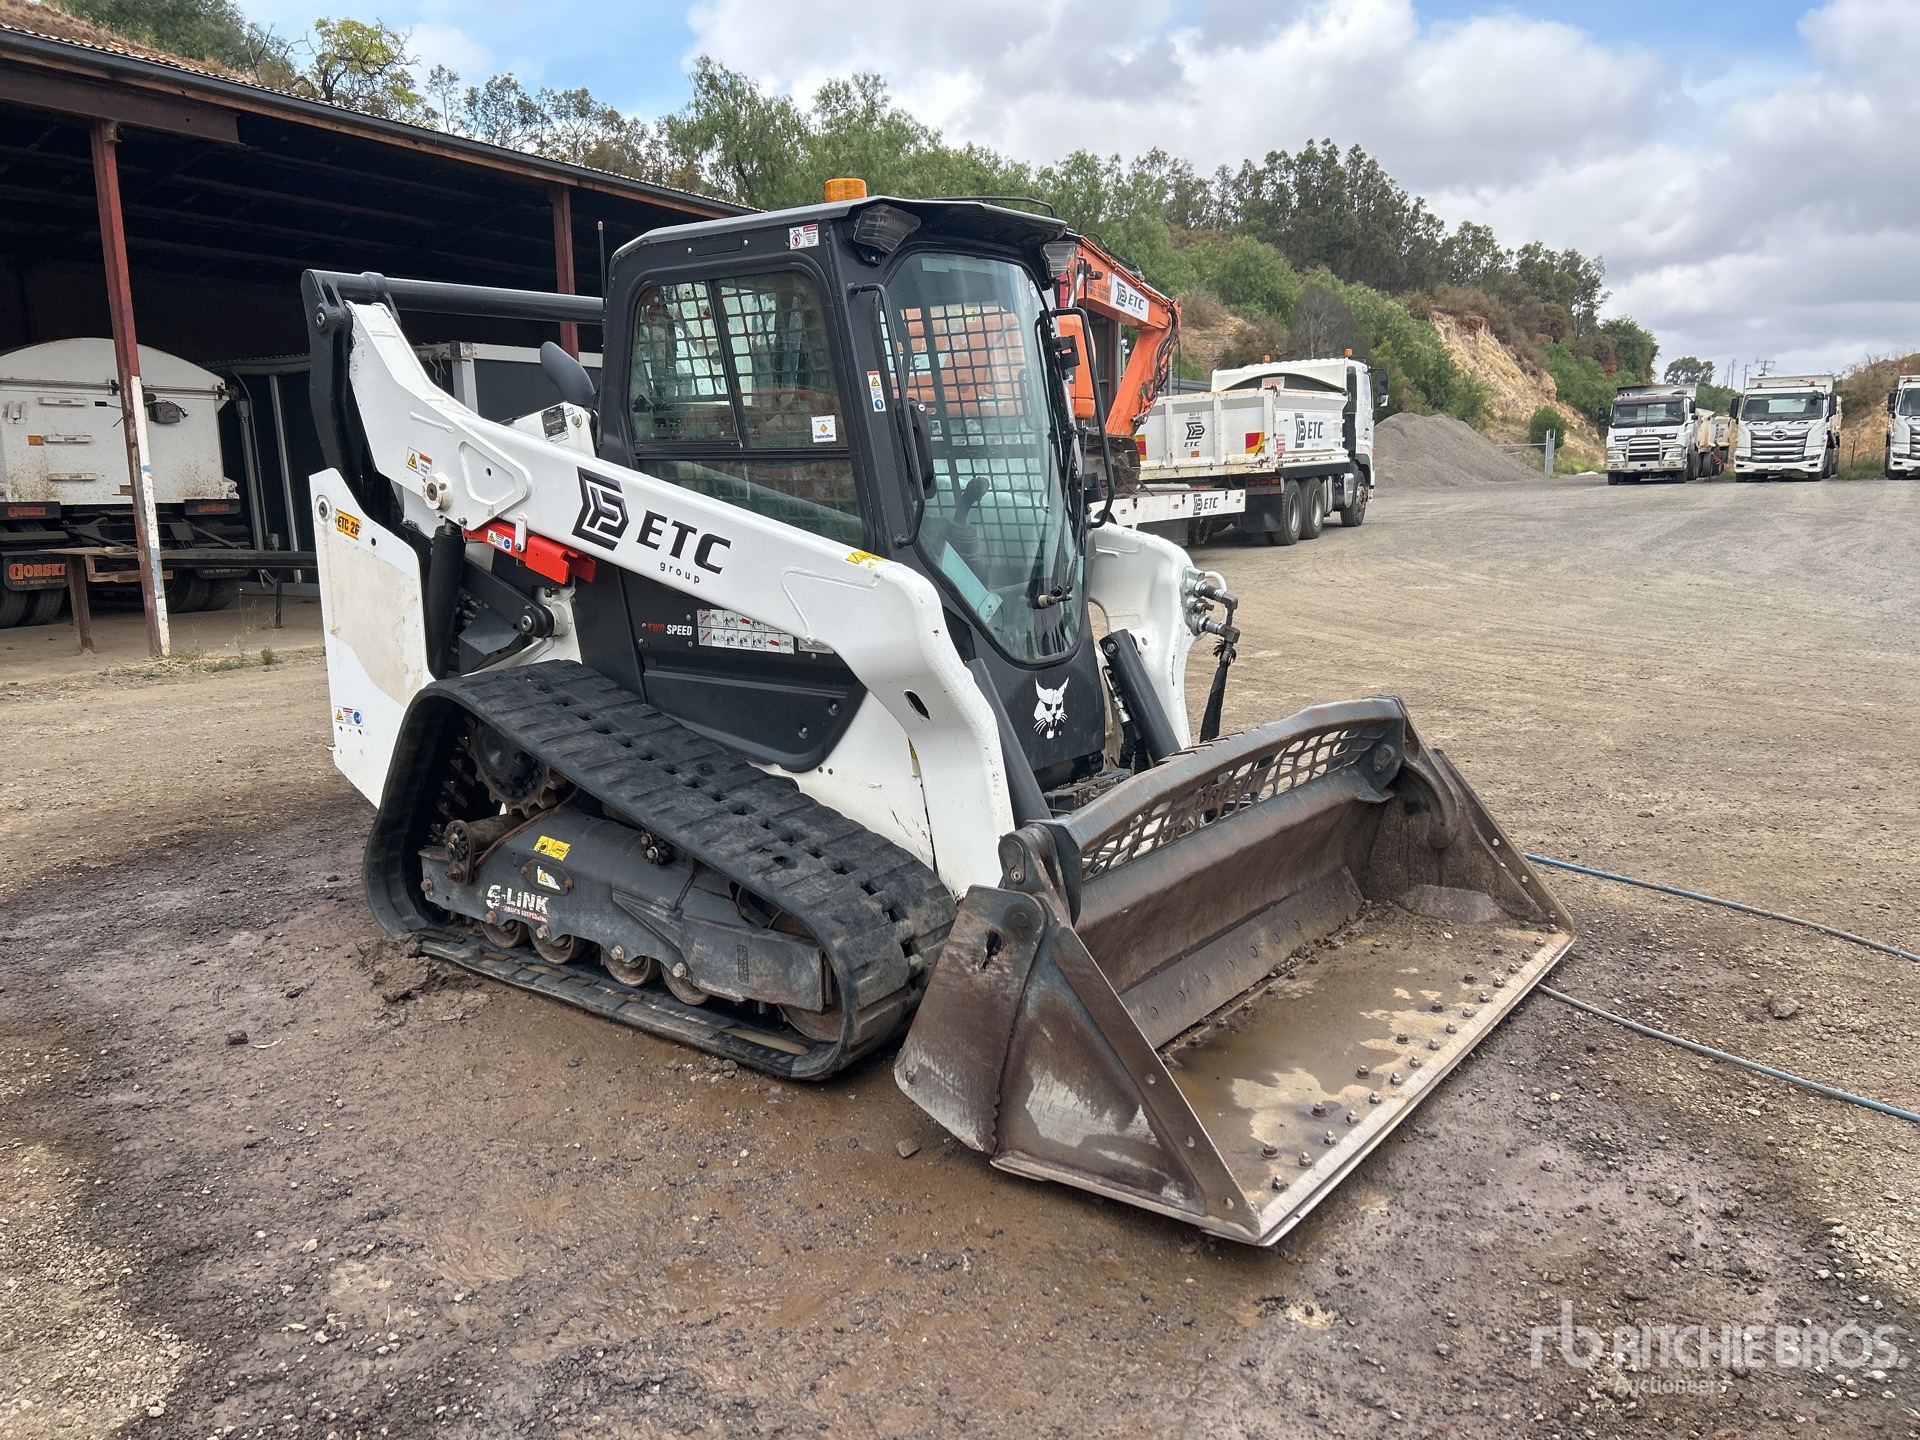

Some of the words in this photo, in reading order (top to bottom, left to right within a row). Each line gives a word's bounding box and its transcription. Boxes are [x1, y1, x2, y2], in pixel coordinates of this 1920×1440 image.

[1128, 293, 1145, 310] ETC
[1307, 422, 1323, 439] ETC
[1203, 497, 1219, 509] ETC
[337, 516, 350, 531] ETC
[636, 510, 732, 574] ETC
[9, 563, 66, 580] GORSKI
[659, 561, 700, 584] group
[647, 623, 665, 633] TWO
[666, 624, 693, 636] SPEED
